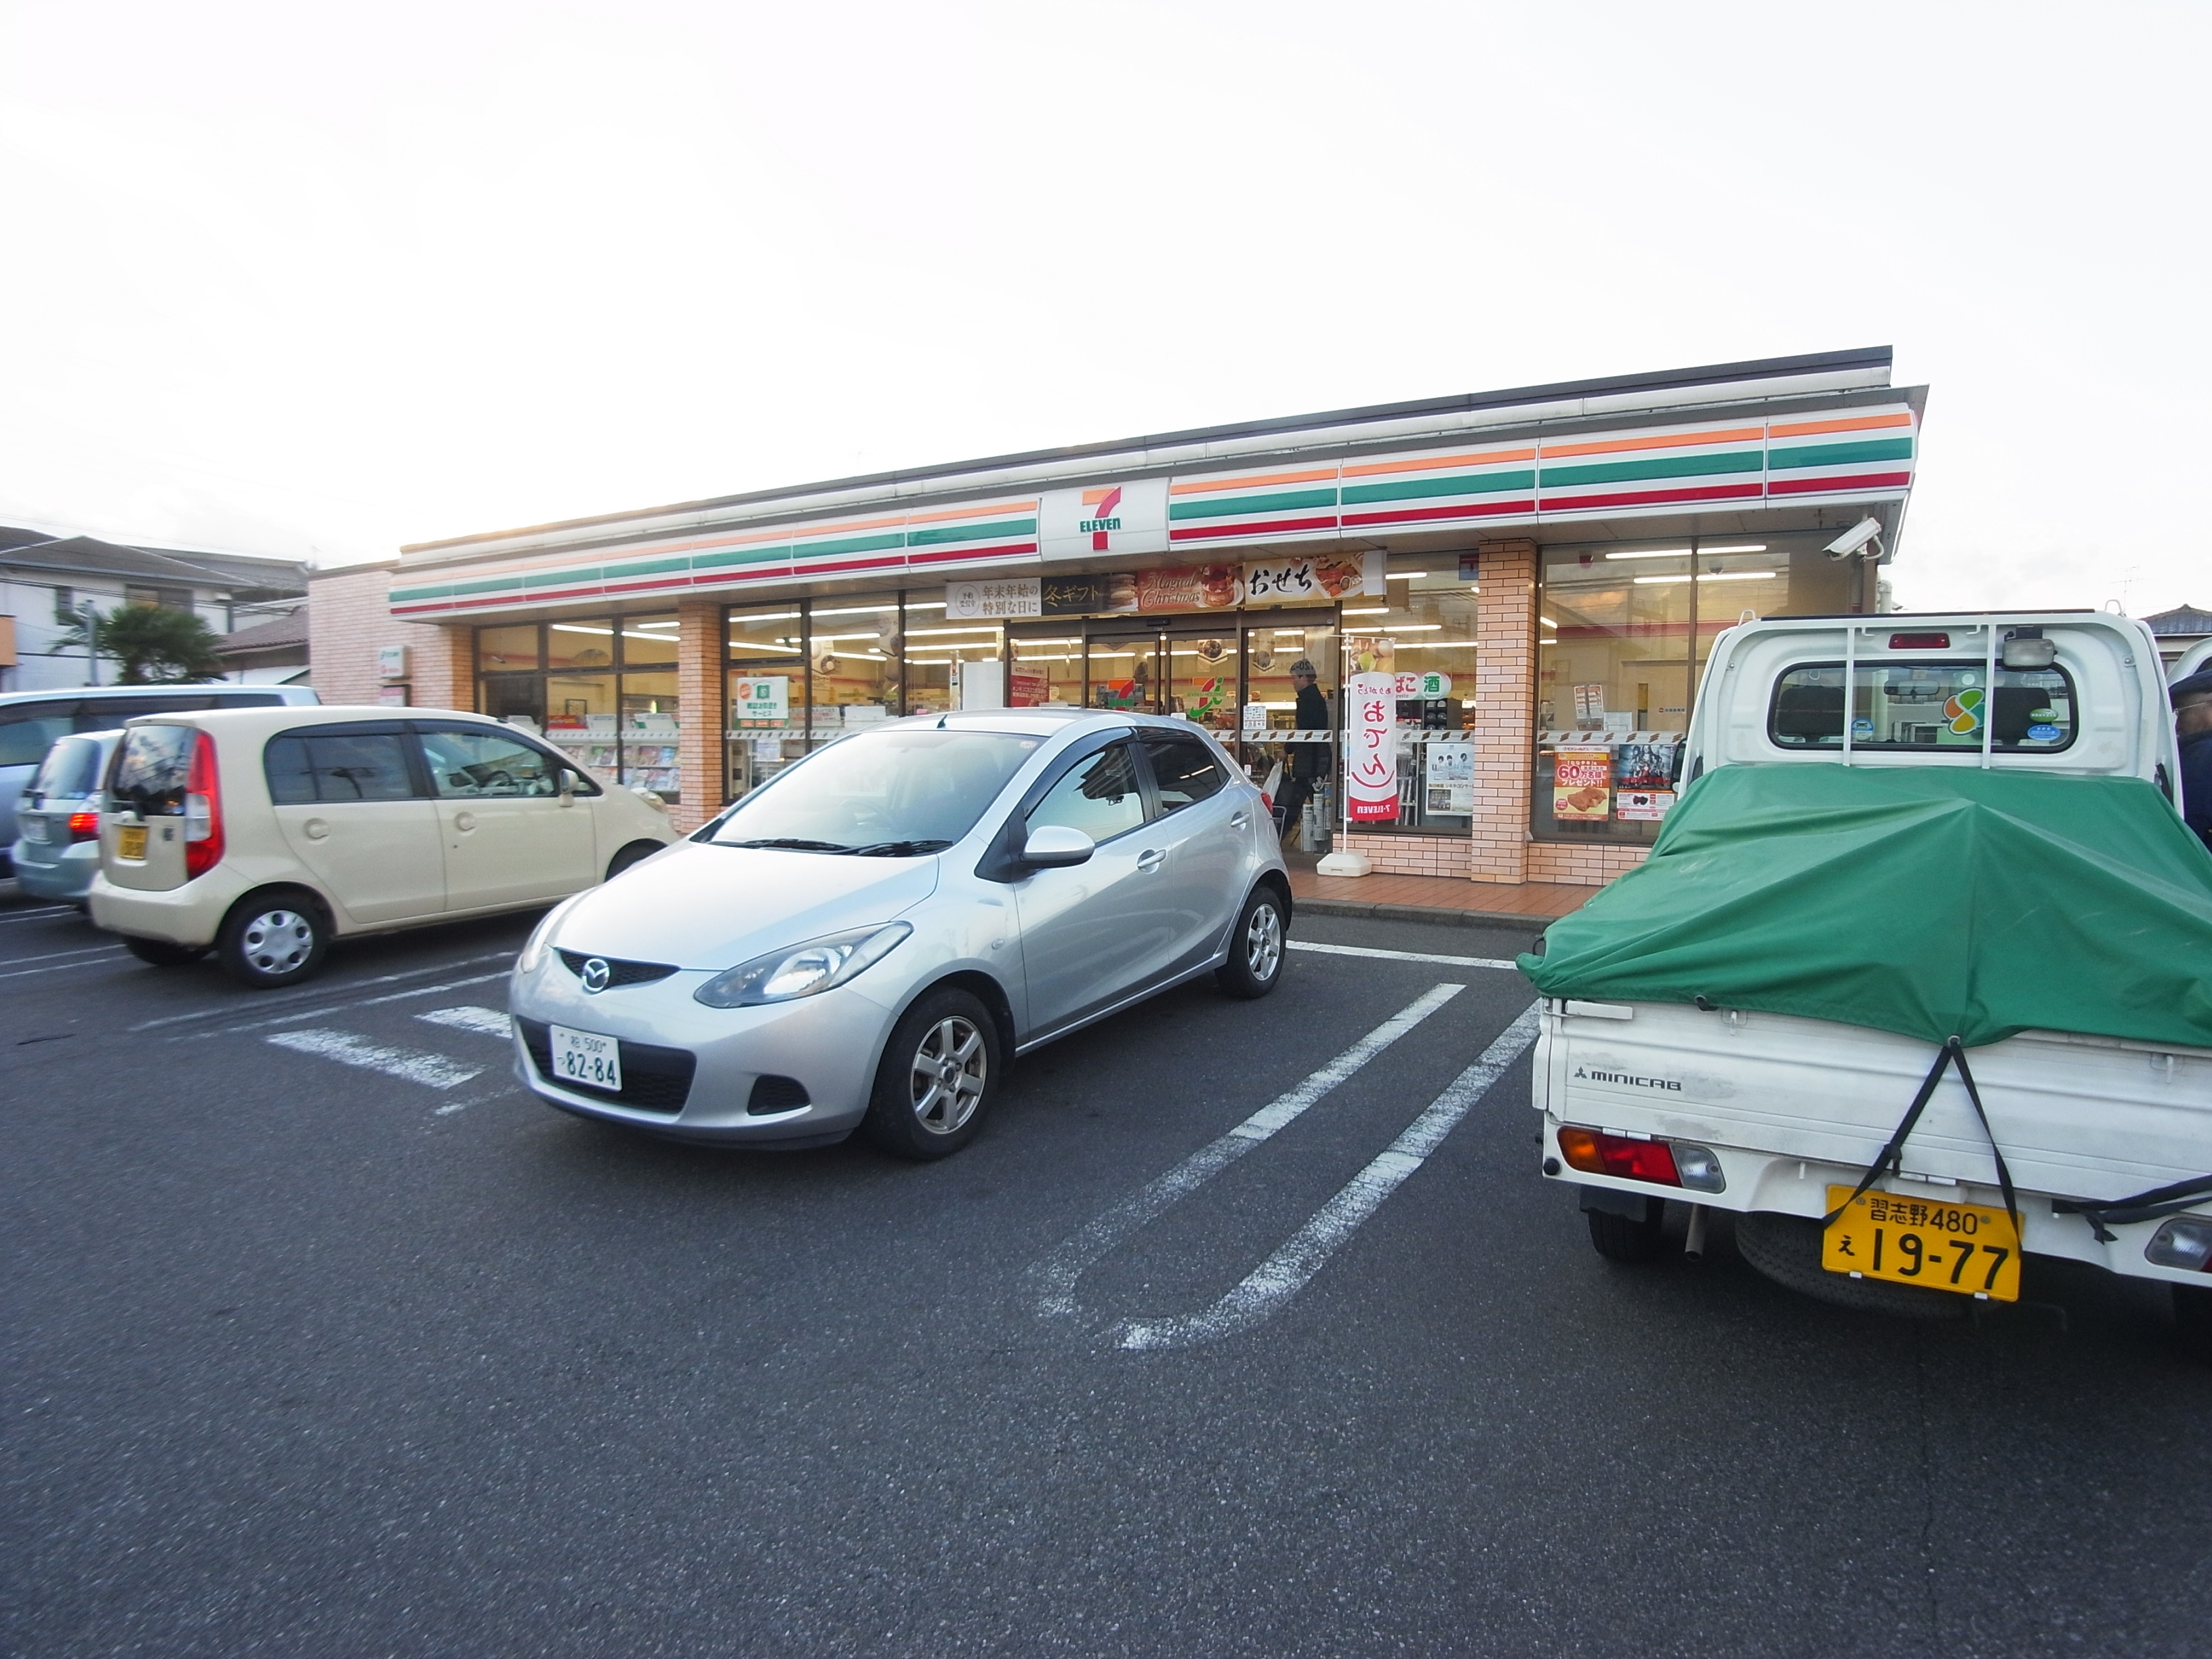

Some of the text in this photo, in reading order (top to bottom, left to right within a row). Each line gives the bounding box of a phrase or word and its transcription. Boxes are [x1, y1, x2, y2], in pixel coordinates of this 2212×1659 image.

[1143, 572, 1195, 591] Magical
[1250, 564, 1312, 595] おせち
[983, 584, 1038, 598] 年末年始の
[1044, 585, 1099, 607] 冬ギフト
[1142, 590, 1200, 608] Christmas
[983, 600, 1038, 615] 特別な日に
[1395, 676, 1416, 693] ばこ
[1423, 676, 1440, 693] 酒
[567, 1050, 617, 1085] 82-84
[1591, 1071, 1681, 1091] MINICAB
[1838, 1228, 2009, 1290] え 19-77
